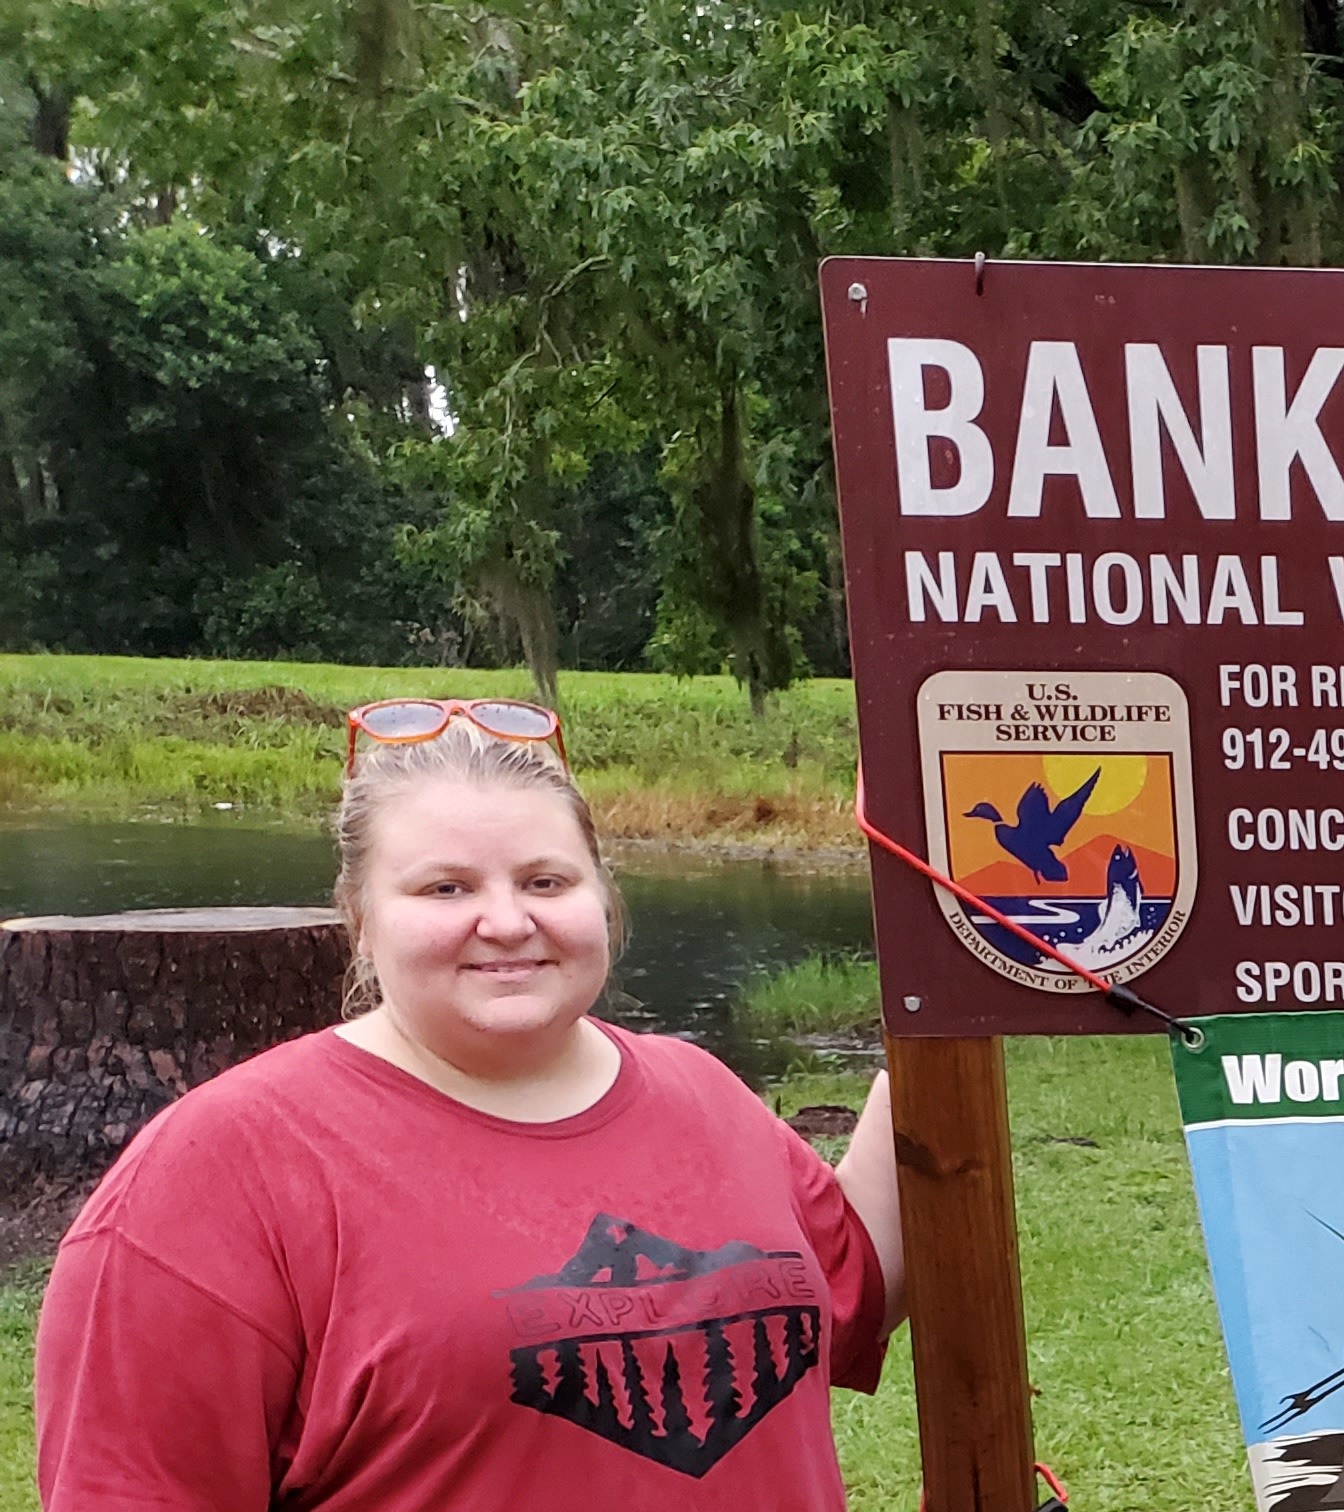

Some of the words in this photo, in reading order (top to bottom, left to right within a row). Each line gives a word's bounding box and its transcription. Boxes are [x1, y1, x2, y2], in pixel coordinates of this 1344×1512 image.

[905, 551, 1303, 625] NATIONAL
[1026, 684, 1078, 701] U.S.
[1220, 664, 1298, 707] FOR
[938, 704, 1003, 721] FISH
[1011, 704, 1030, 721] &
[1034, 705, 1170, 721] WILDLIFE
[996, 724, 1115, 741] SERVICE
[949, 911, 1050, 988] DEPARTMENT
[1054, 979, 1079, 990] OF
[1126, 909, 1186, 976] INTERIOR
